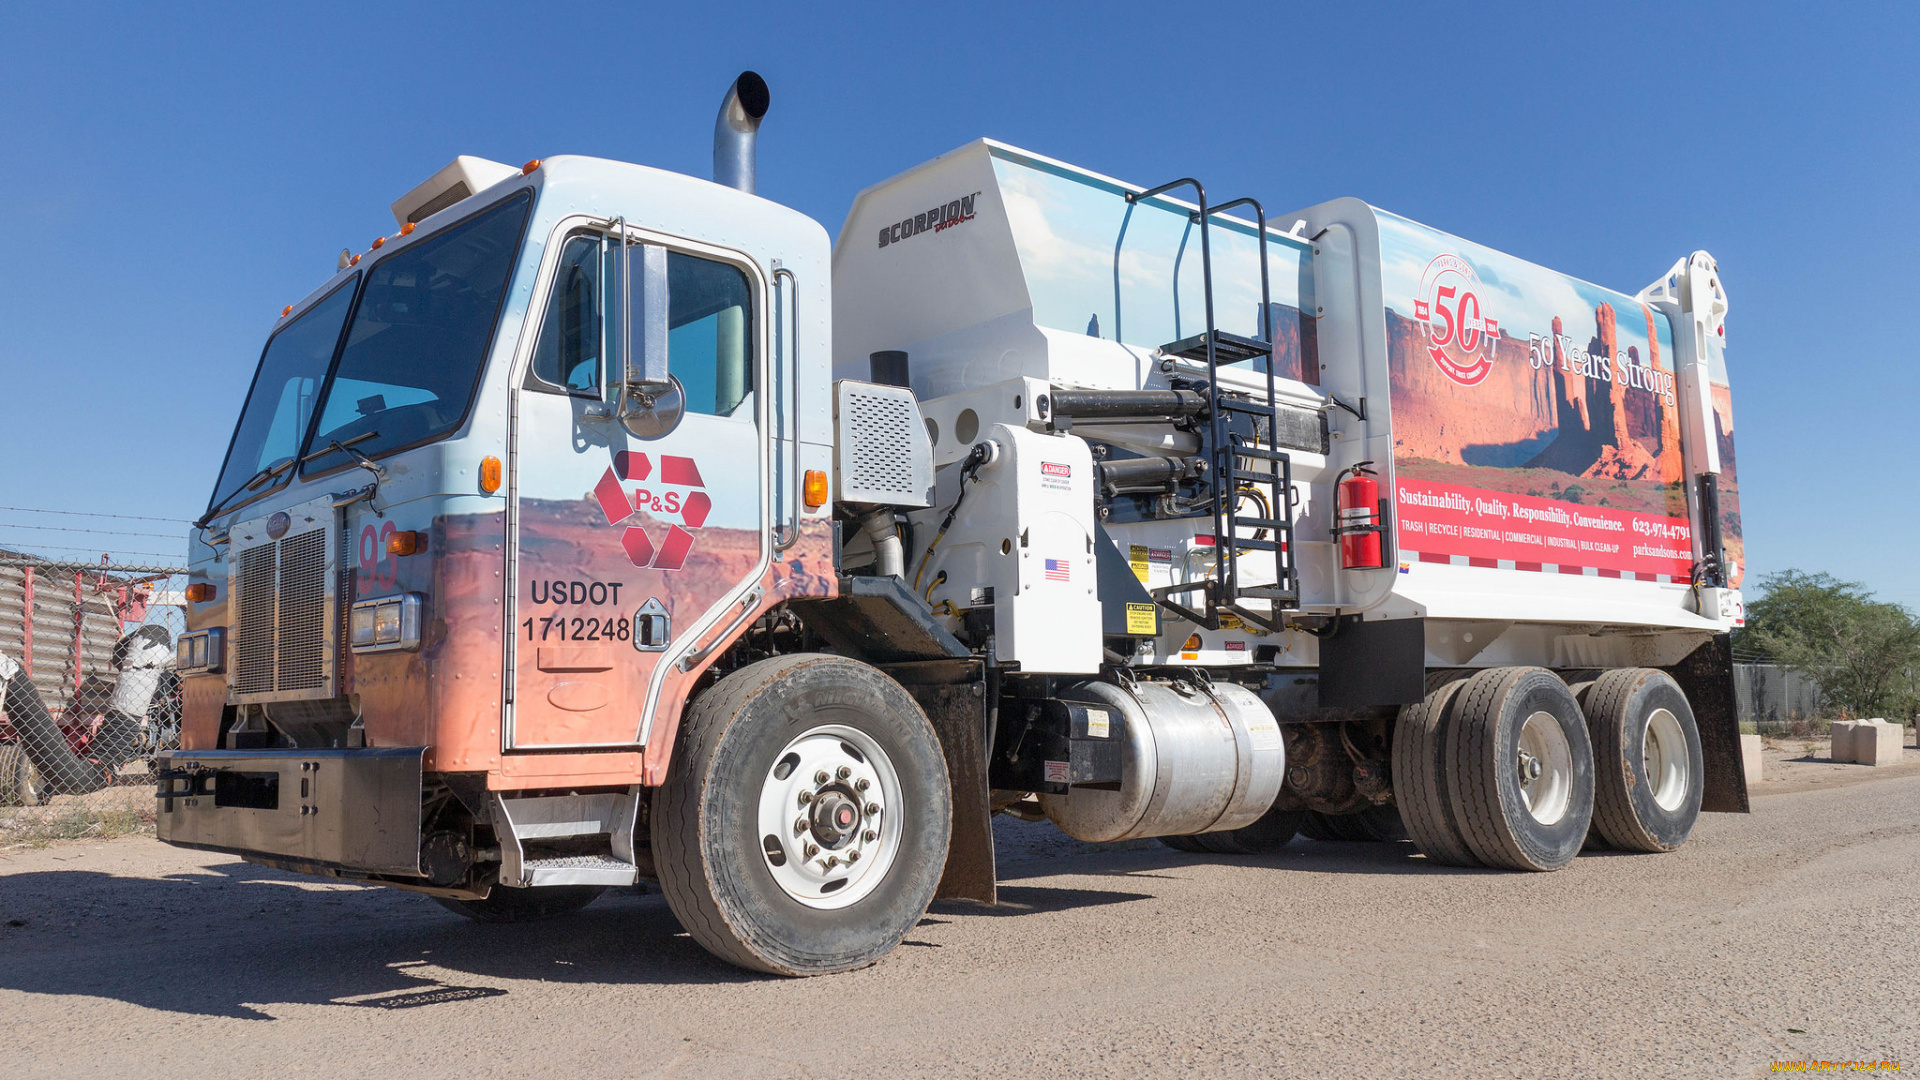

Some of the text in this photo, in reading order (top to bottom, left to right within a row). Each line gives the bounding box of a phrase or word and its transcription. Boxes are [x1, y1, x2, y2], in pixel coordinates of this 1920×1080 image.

[878, 193, 976, 248] SCORPION
[1430, 285, 1480, 352] 50
[1528, 332, 1675, 407] 50 Years Strong
[1048, 465, 1068, 475] DANGER
[635, 488, 681, 514] P&S
[1399, 487, 1625, 532] Sustainability. Quality. Responsibility. Convenience.
[1401, 519, 1620, 554] TRASH RECYCLE RESIDENTIAL COMMERCIAL INDUSTRIAL BULK CLEAN-UP
[1632, 517, 1691, 541] 623.974.4791
[359, 520, 398, 595] 93
[1633, 543, 1693, 560] parksandsons.com
[531, 580, 624, 606] USDOT
[522, 617, 630, 642] 1712248
